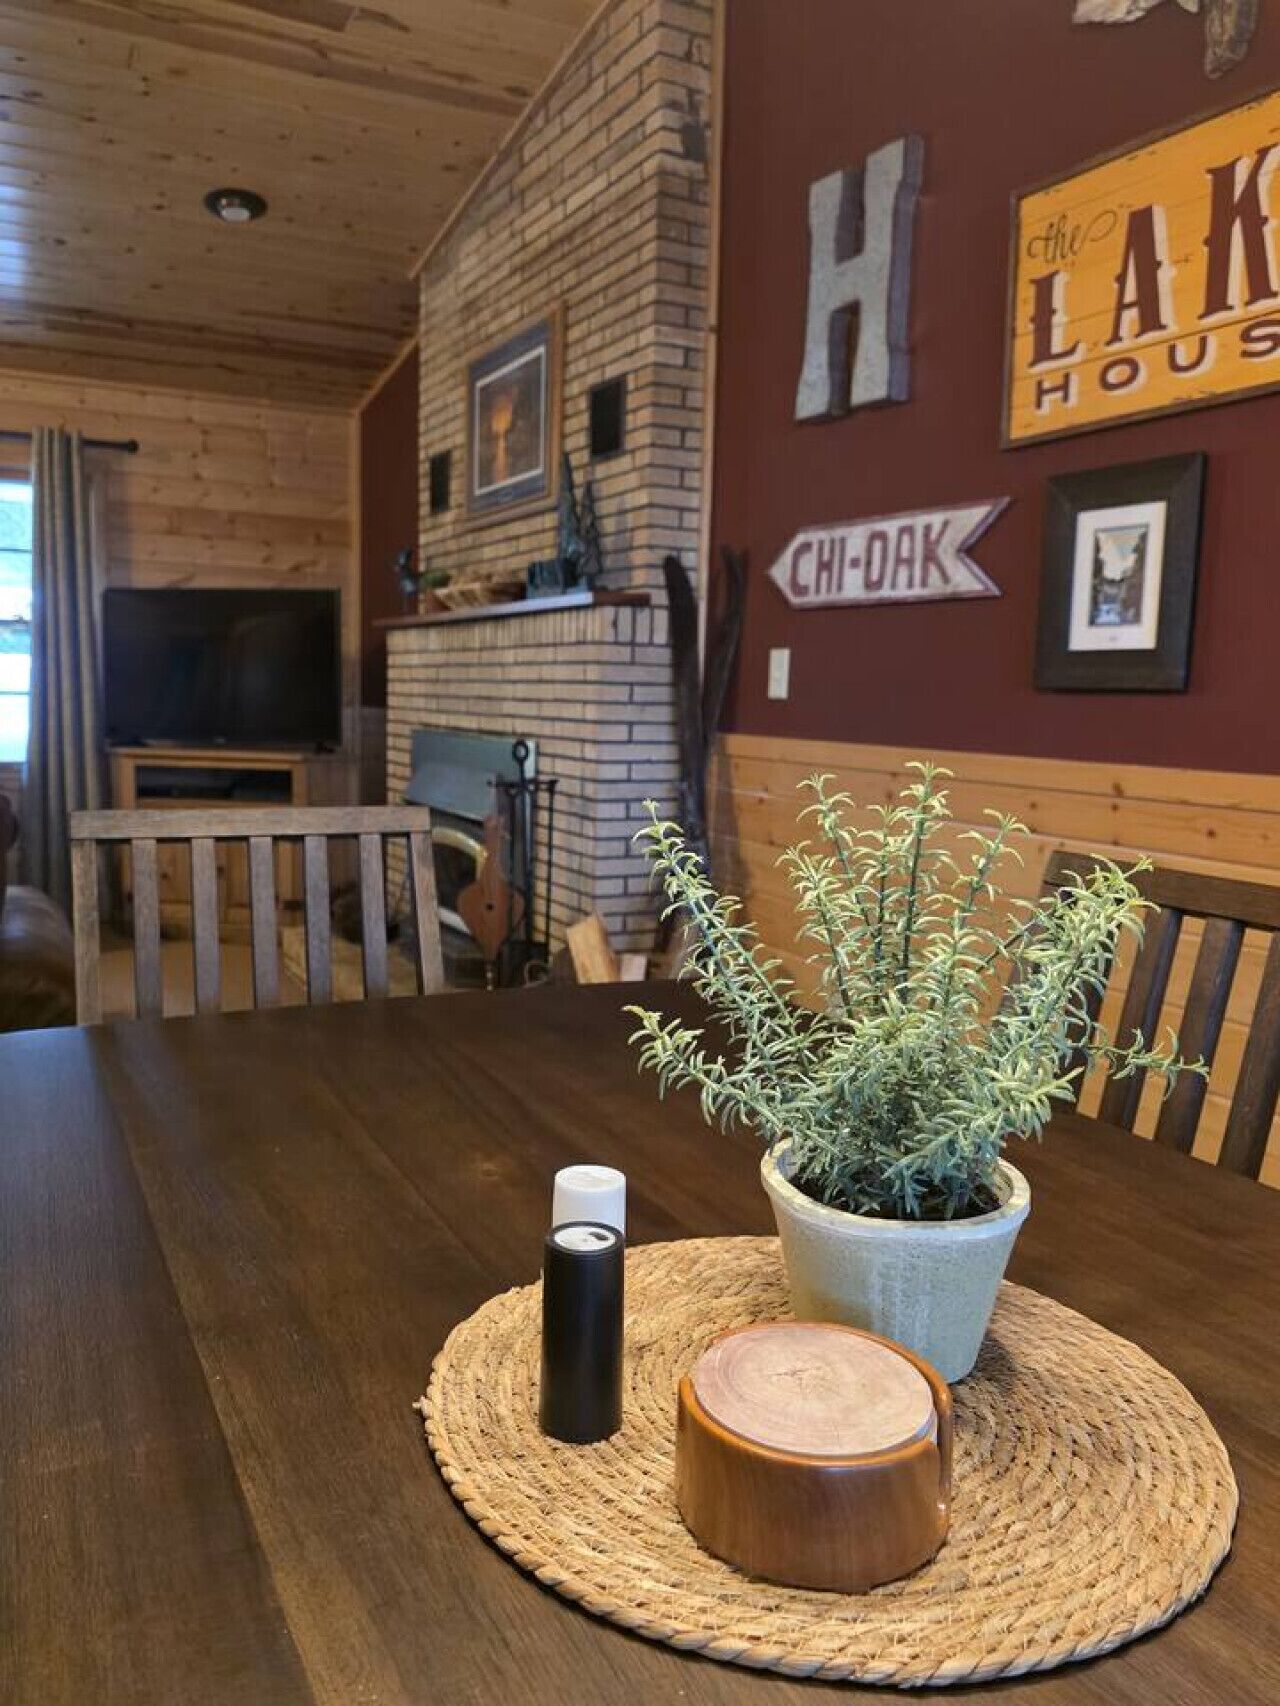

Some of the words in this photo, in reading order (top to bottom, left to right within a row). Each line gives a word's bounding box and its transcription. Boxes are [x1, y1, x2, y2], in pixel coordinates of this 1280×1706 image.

[1027, 210, 1117, 263] the
[795, 136, 923, 420] H
[790, 519, 951, 598] CHI-OAK
